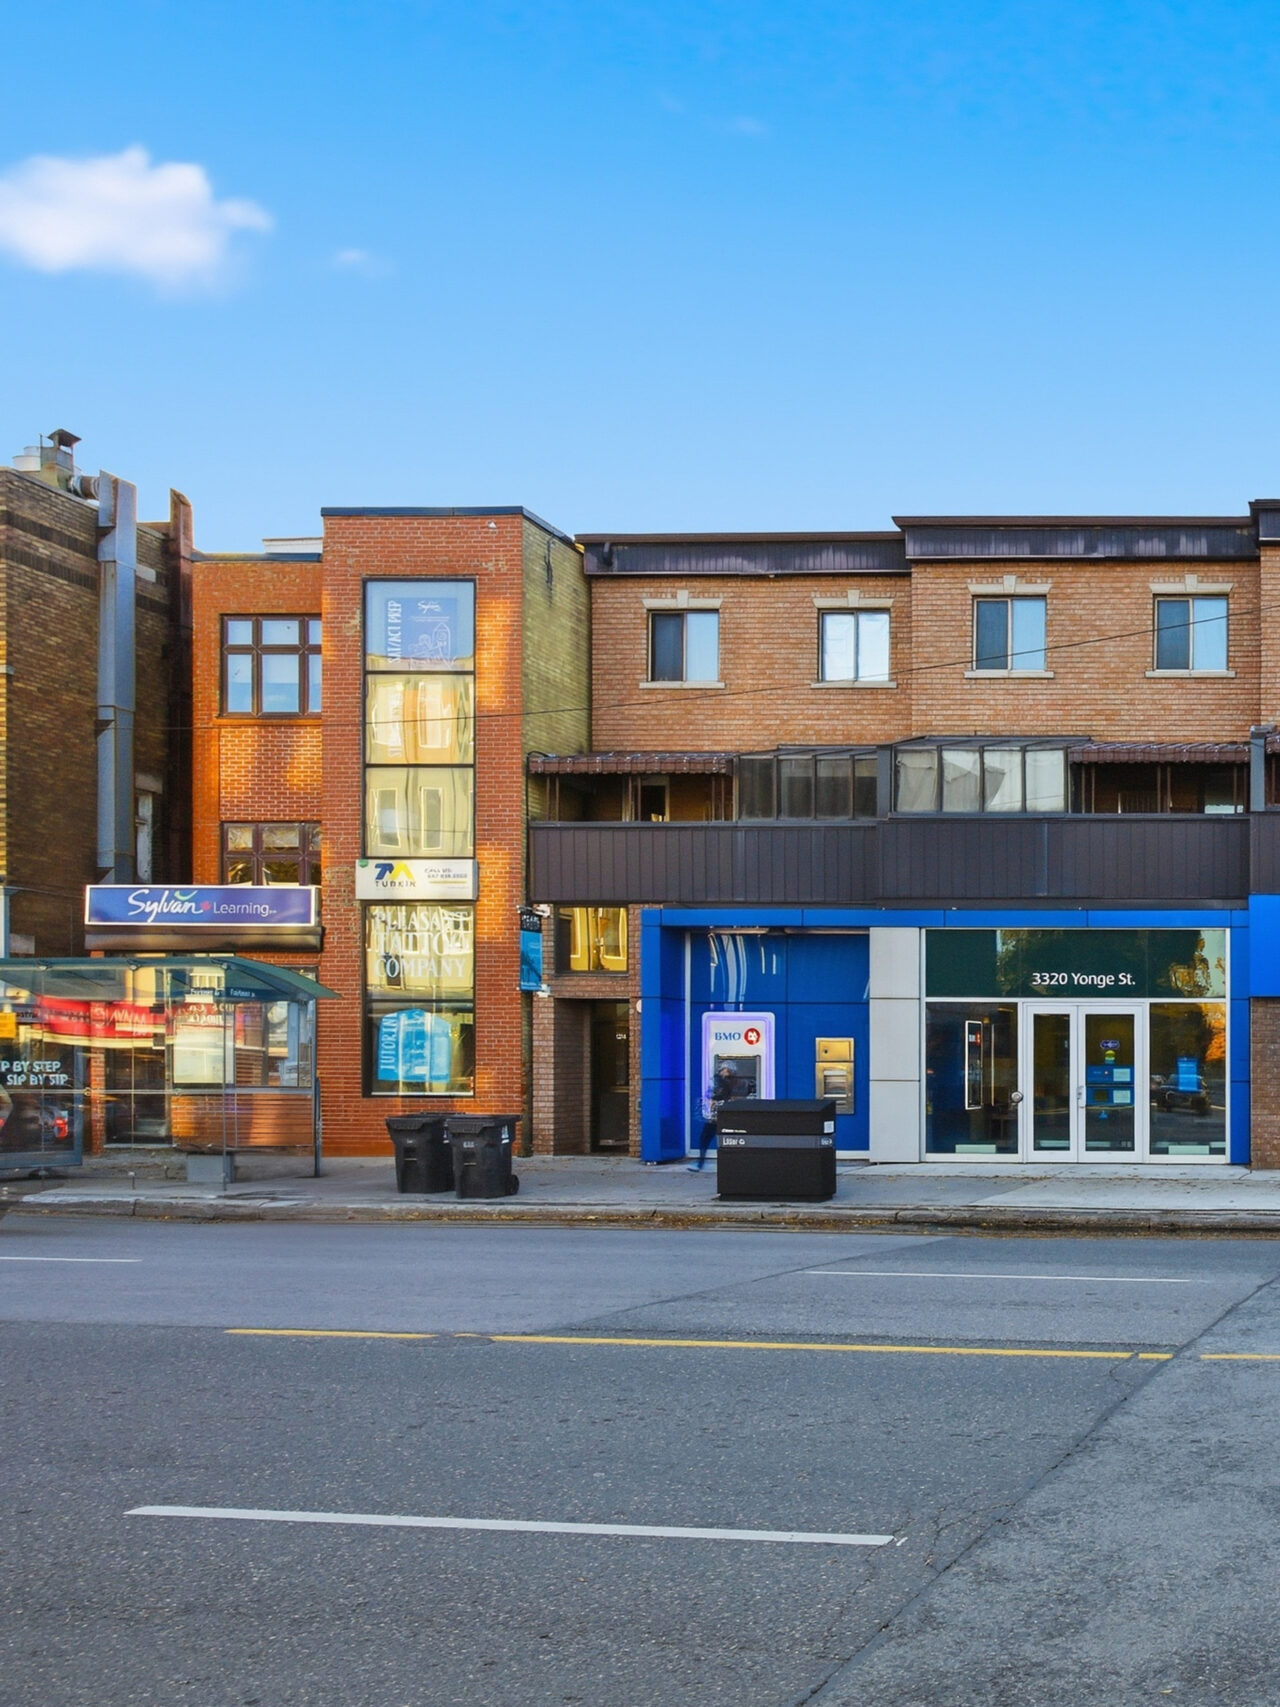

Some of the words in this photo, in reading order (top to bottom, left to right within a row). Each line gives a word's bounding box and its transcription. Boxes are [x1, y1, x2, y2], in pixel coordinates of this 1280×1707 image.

[127, 889, 203, 923] Sylvan
[213, 902, 269, 917] Learning
[374, 958, 466, 978] COMPANY
[1032, 972, 1068, 985] 3320
[1071, 972, 1115, 988] Yonge
[1118, 972, 1136, 985] St.
[714, 1032, 741, 1040] BMO
[12, 1060, 29, 1073] BY
[33, 1060, 61, 1073] STEP
[6, 1074, 27, 1086] SIP
[29, 1074, 45, 1086] BY
[49, 1074, 69, 1086] SIP
